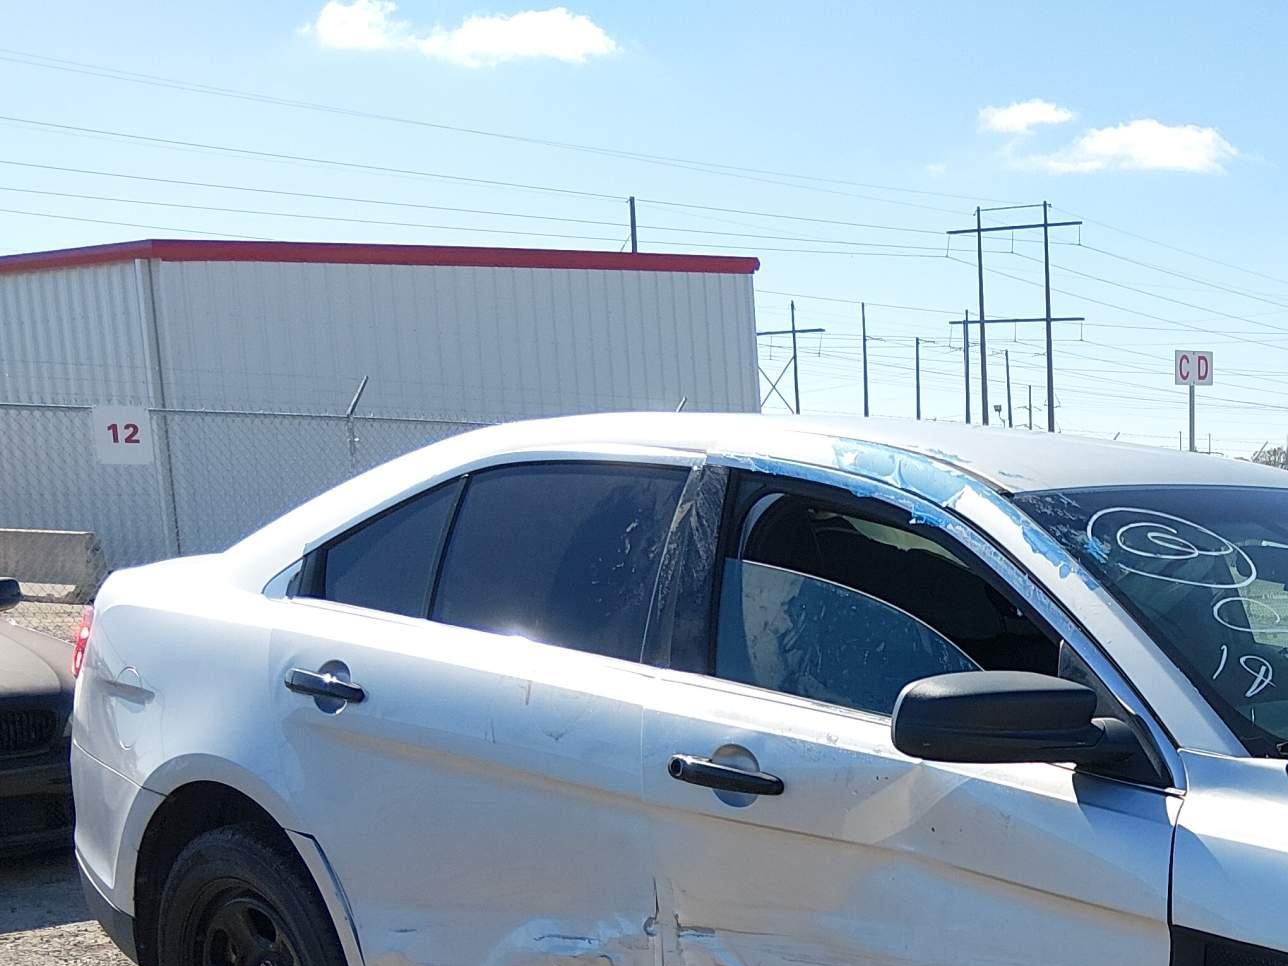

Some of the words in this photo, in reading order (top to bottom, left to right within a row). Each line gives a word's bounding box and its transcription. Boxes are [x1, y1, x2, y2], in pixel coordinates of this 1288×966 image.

[1179, 354, 1190, 381] C
[1197, 355, 1209, 381] D
[107, 423, 141, 444] 12
